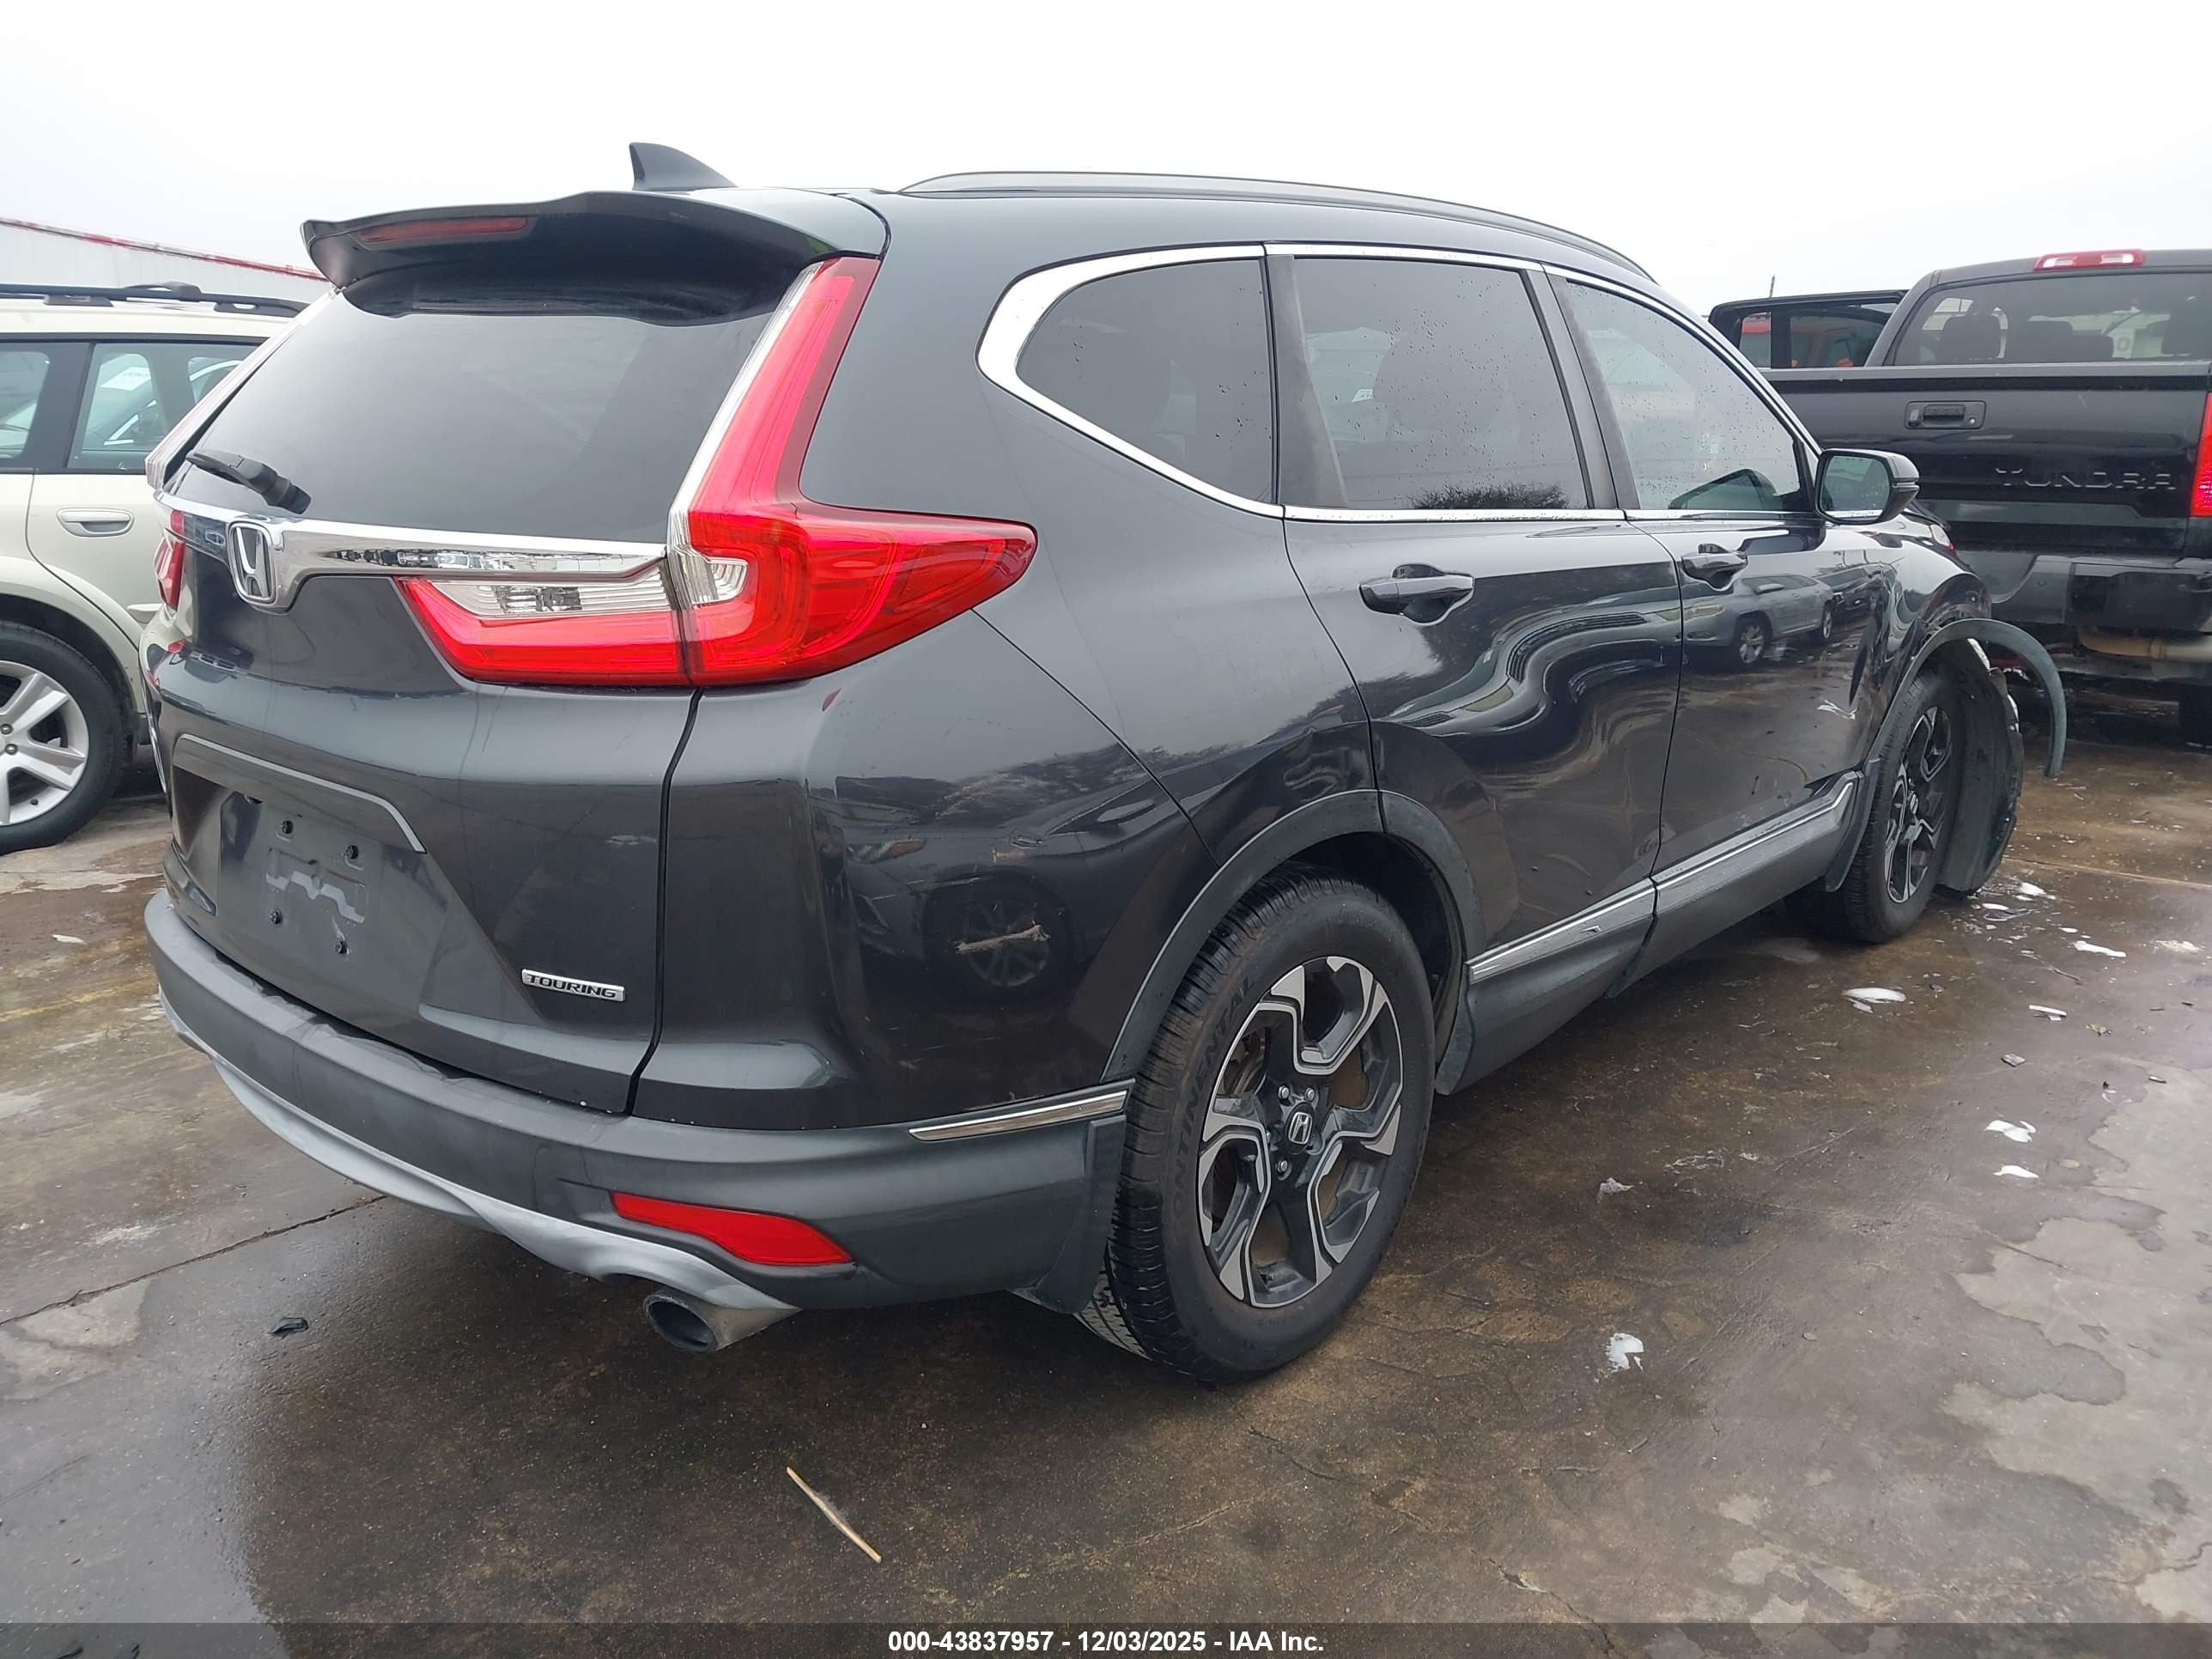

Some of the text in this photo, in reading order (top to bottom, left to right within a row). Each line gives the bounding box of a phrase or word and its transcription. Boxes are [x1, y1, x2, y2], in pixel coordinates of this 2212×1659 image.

[1995, 467, 2177, 490] TUNDRA
[526, 974, 617, 998] TOURING
[1173, 975, 1257, 1226] ONTINENTAL
